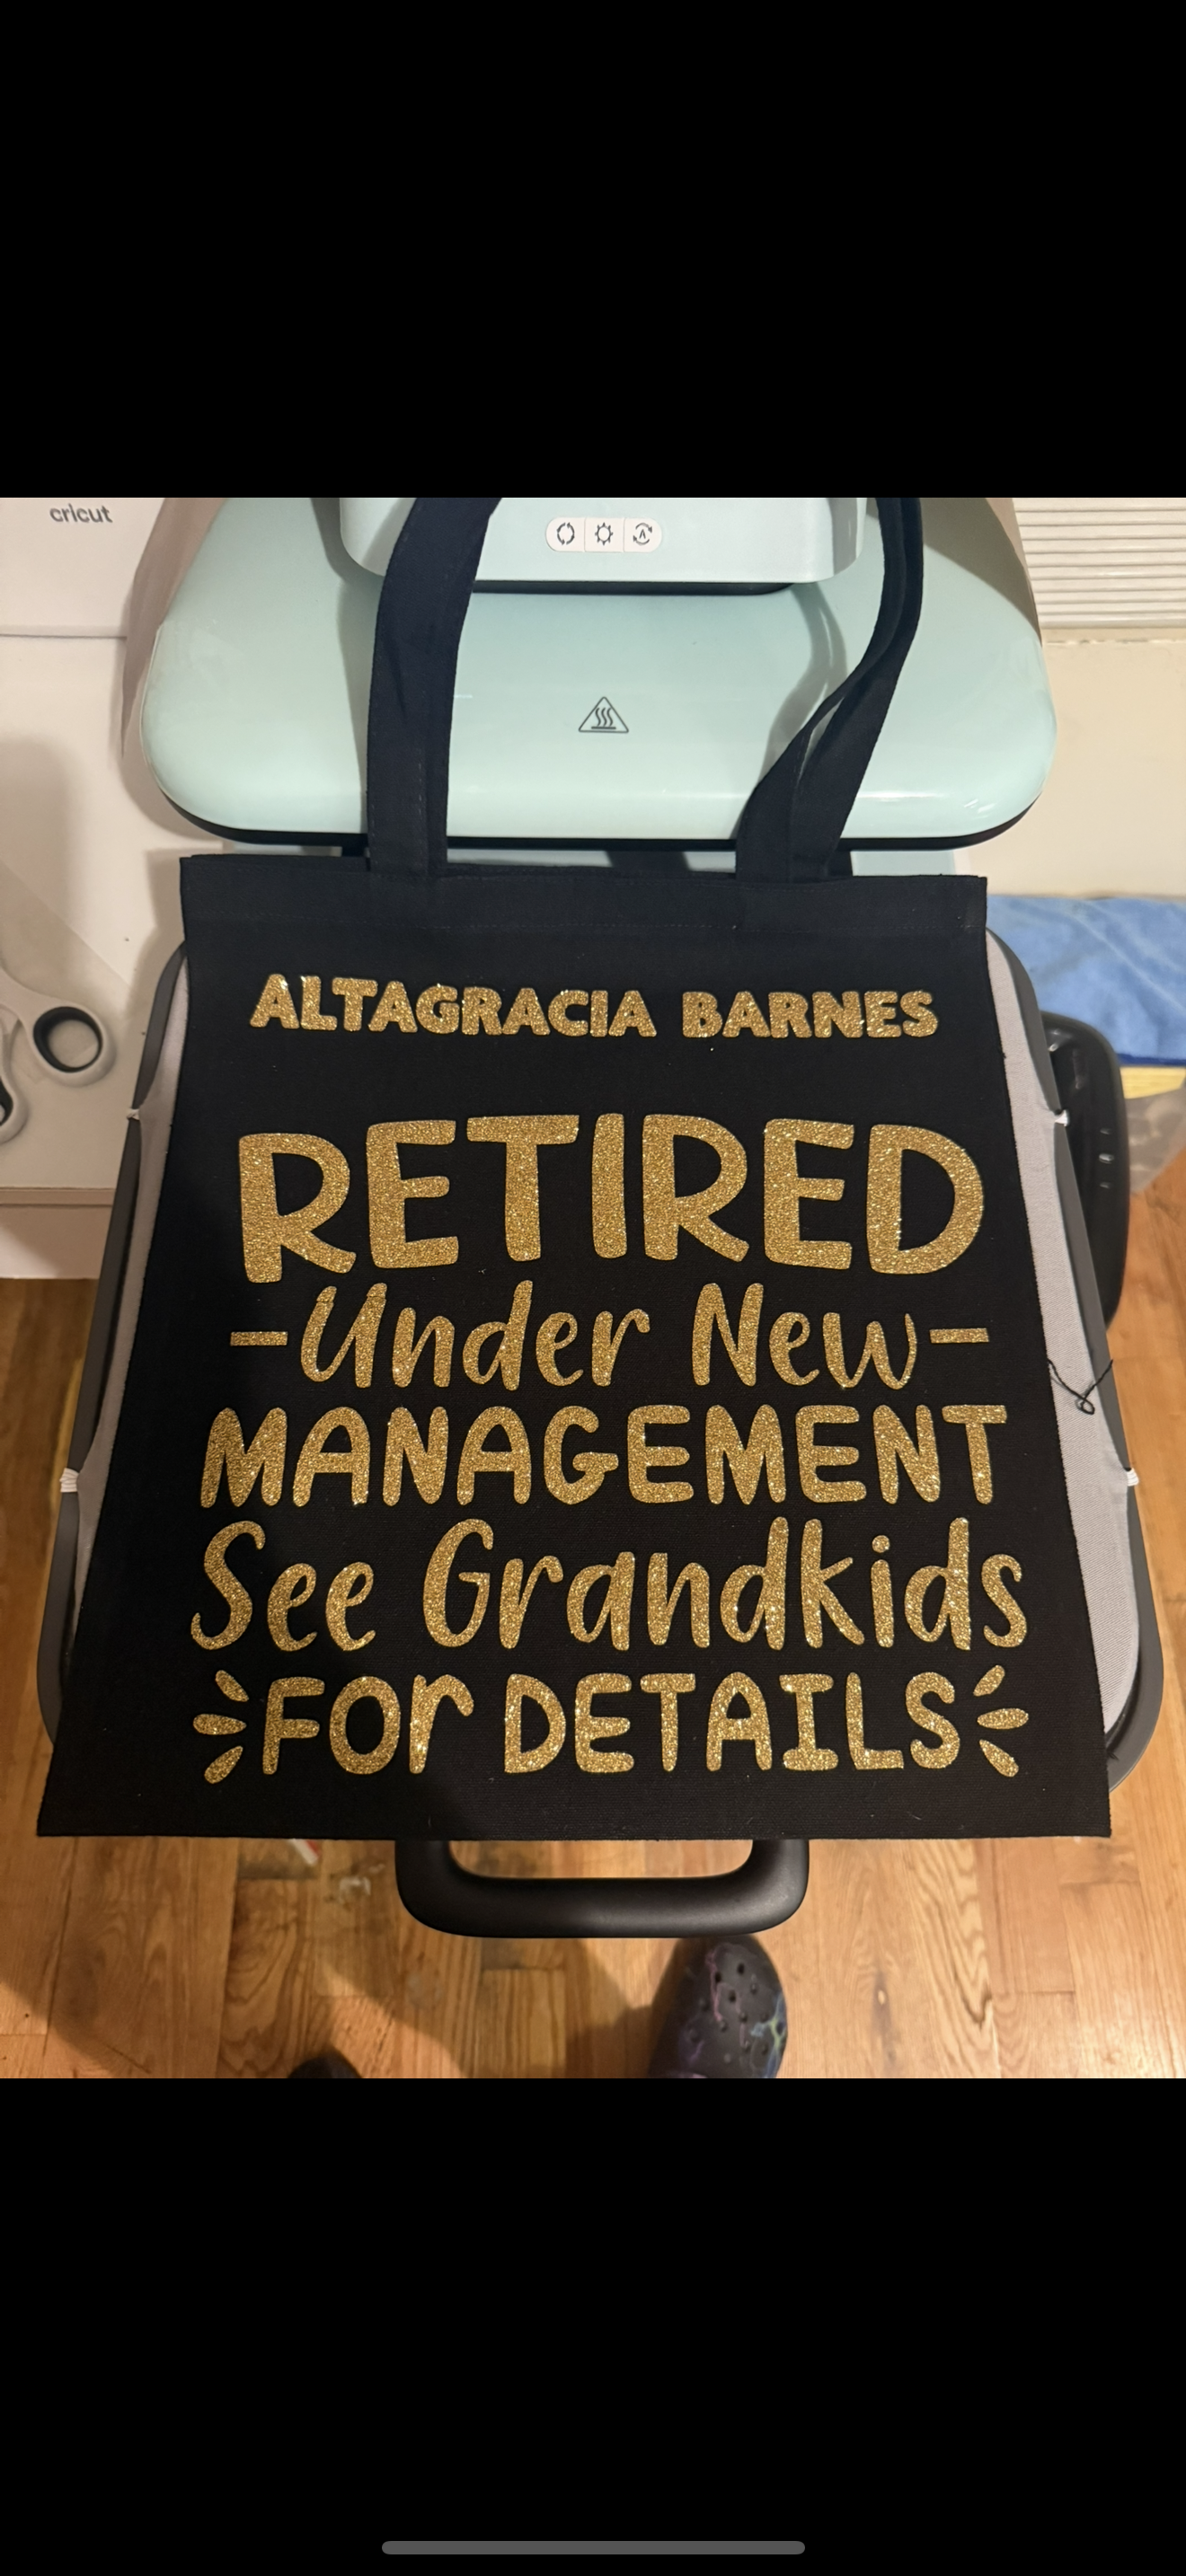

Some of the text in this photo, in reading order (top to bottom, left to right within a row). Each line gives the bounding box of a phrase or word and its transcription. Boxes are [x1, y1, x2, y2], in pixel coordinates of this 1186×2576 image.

[49, 503, 113, 523] cricut
[250, 974, 939, 1039] ALTAGRACIA BARNES
[239, 1113, 985, 1284] RETIRED
[200, 1404, 1008, 1508] MANAGEMENT
[190, 1516, 1028, 1652] See Grandkids
[504, 1671, 961, 1774] DETAILS
